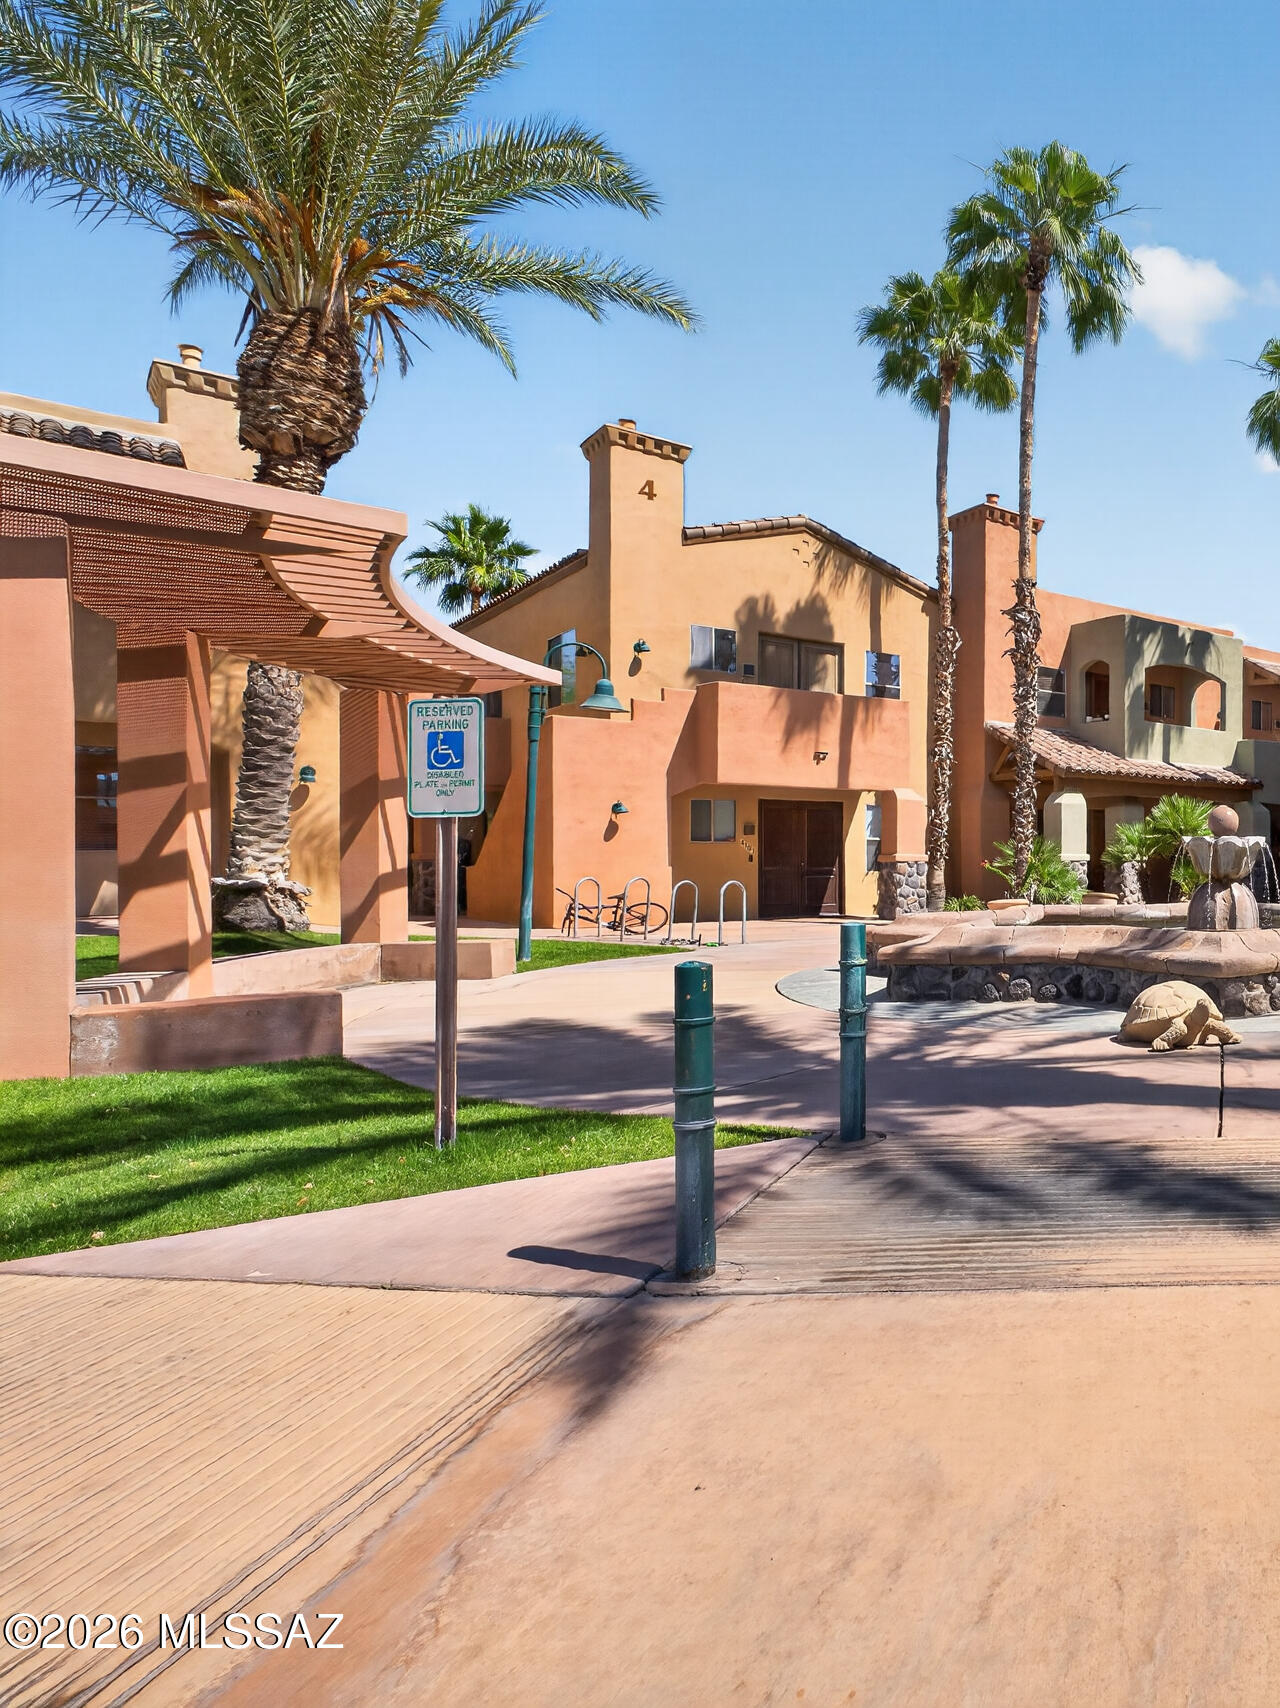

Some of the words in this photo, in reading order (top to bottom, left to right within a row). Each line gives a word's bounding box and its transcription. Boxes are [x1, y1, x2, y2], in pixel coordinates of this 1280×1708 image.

[638, 480, 657, 500] 4
[416, 705, 474, 717] RESERVED
[422, 719, 469, 730] PARKING
[427, 771, 465, 779] DISABLED
[414, 780, 439, 788] PLATE
[449, 779, 475, 787] PERMIT
[435, 789, 454, 797] ONLY
